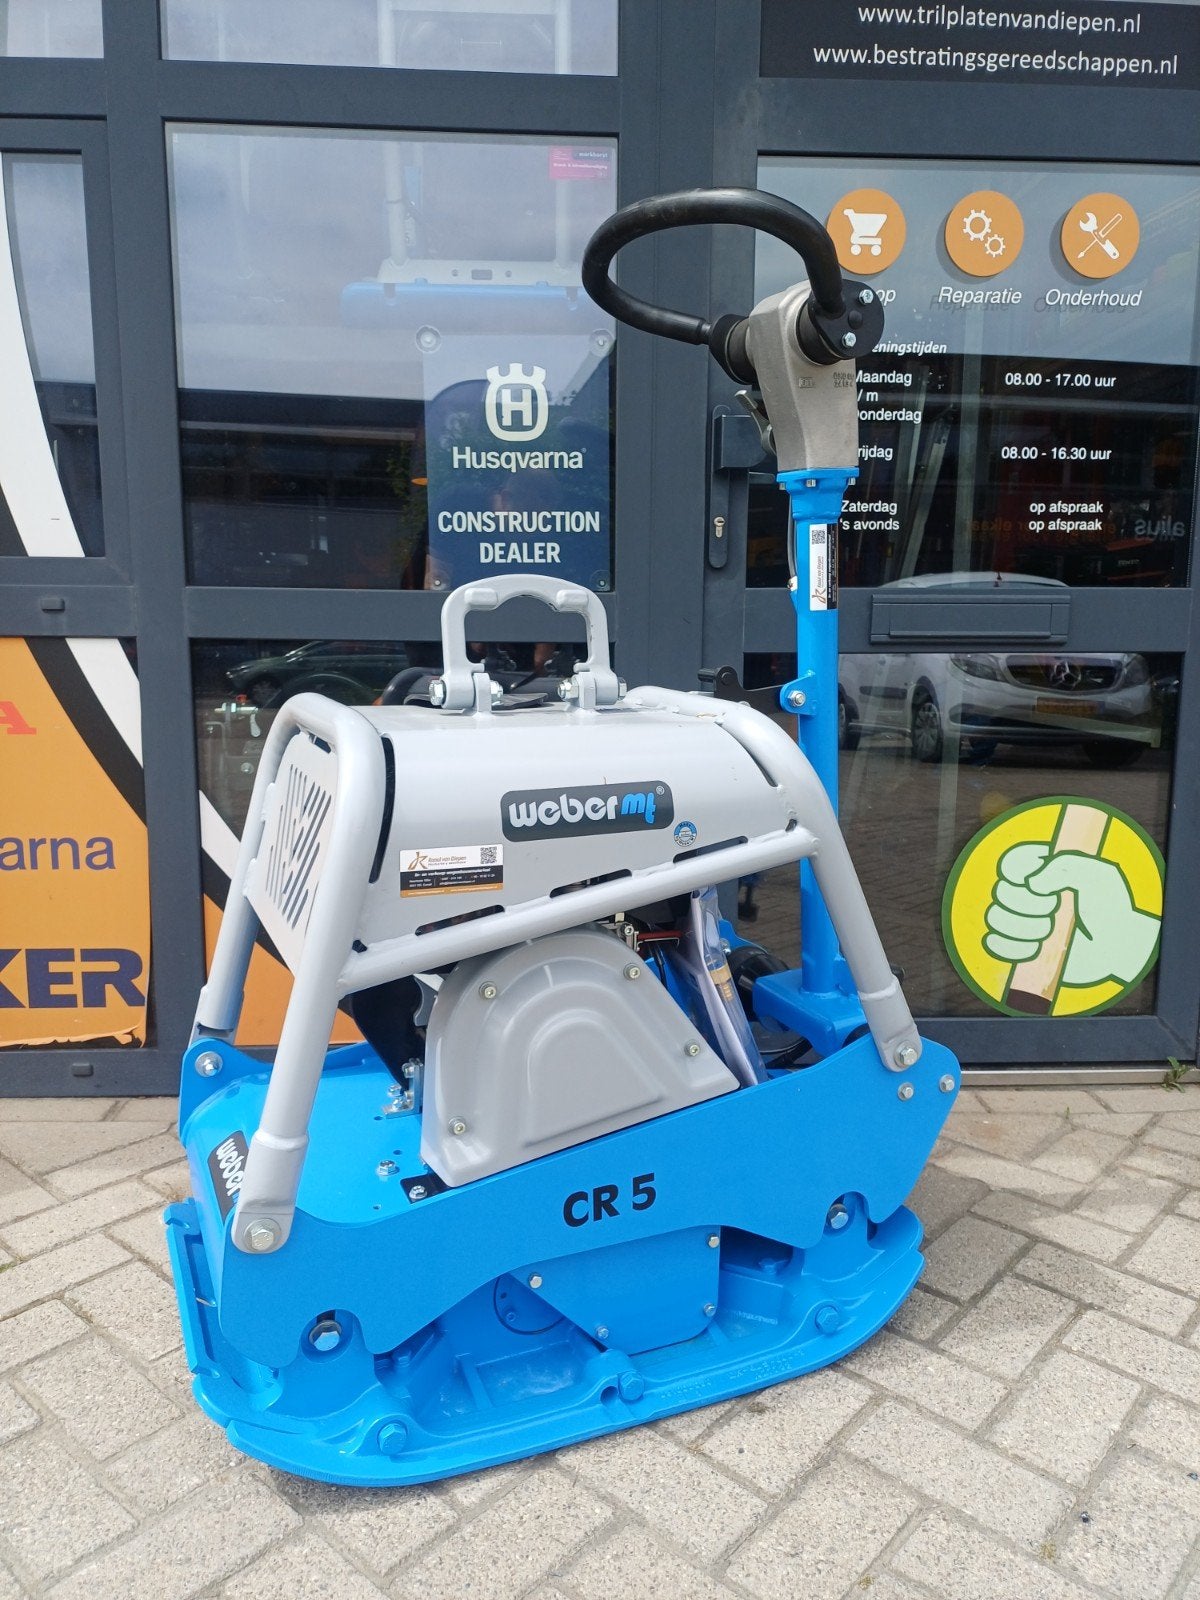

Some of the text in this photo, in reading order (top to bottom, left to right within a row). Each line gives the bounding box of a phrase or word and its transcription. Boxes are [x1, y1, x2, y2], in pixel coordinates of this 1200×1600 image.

[858, 4, 1142, 34] www.trilplatenvandiepen.nl
[813, 44, 1179, 77] www.bestratingsgereedschappen.nl
[938, 286, 1022, 307] Reparatie
[1045, 288, 1143, 307] Onderhoud
[871, 340, 948, 357] eningstijden
[1005, 372, 1042, 386] 08.00
[1055, 373, 1092, 387] 17.00
[1094, 376, 1117, 387] uur
[858, 407, 923, 425] onderdag
[452, 446, 584, 473] Husqvarna
[858, 445, 894, 461] rijdag
[1001, 446, 1039, 460] 08.00
[1051, 447, 1087, 460] 16.30
[1090, 450, 1112, 460] uur
[841, 500, 1104, 515] Zaterdag op afspraak
[438, 511, 600, 533] CONSTRUCTION
[853, 518, 900, 531] avonds
[1028, 520, 1045, 533] op
[1048, 518, 1103, 533] afspraak
[479, 542, 561, 563] DEALER
[563, 1172, 657, 1228] CR 5
